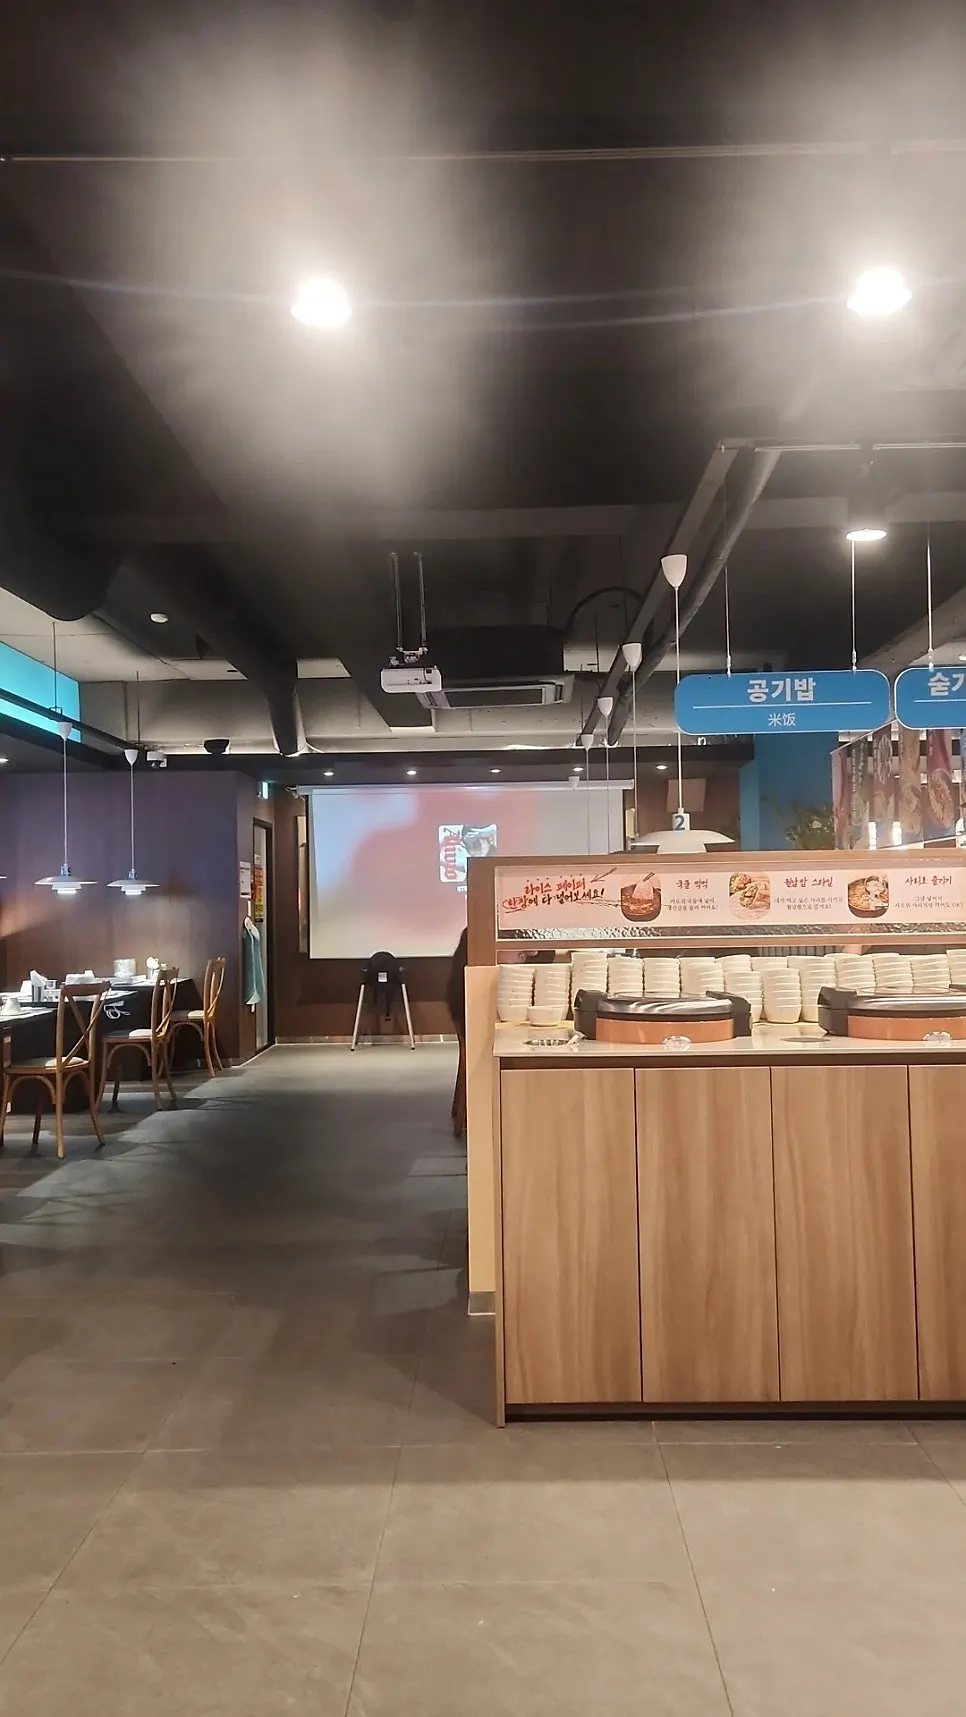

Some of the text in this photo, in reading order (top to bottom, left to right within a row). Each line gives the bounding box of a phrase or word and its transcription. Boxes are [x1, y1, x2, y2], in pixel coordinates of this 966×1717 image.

[747, 676, 817, 703] 공기밥
[768, 712, 797, 727] 米饭
[674, 814, 686, 831] 2
[524, 877, 586, 896] 라이스 페이퍼
[811, 876, 834, 888] 스타일
[541, 893, 553, 906] 다
